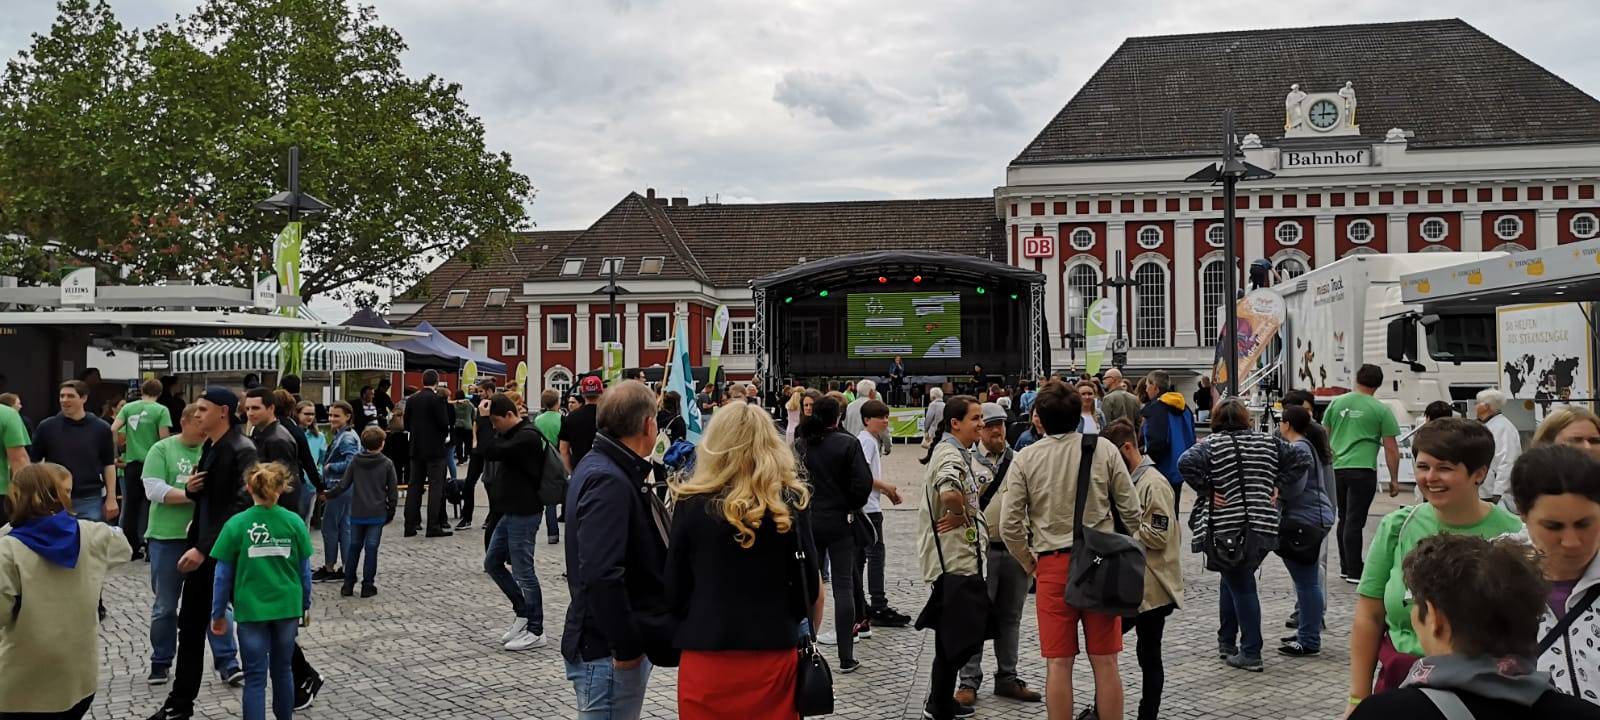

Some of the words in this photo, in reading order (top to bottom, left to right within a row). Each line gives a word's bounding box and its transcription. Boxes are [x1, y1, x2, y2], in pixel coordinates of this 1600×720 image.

[1288, 150, 1364, 166] Bahnhof
[1027, 239, 1051, 255] DB
[253, 532, 270, 544] 72
